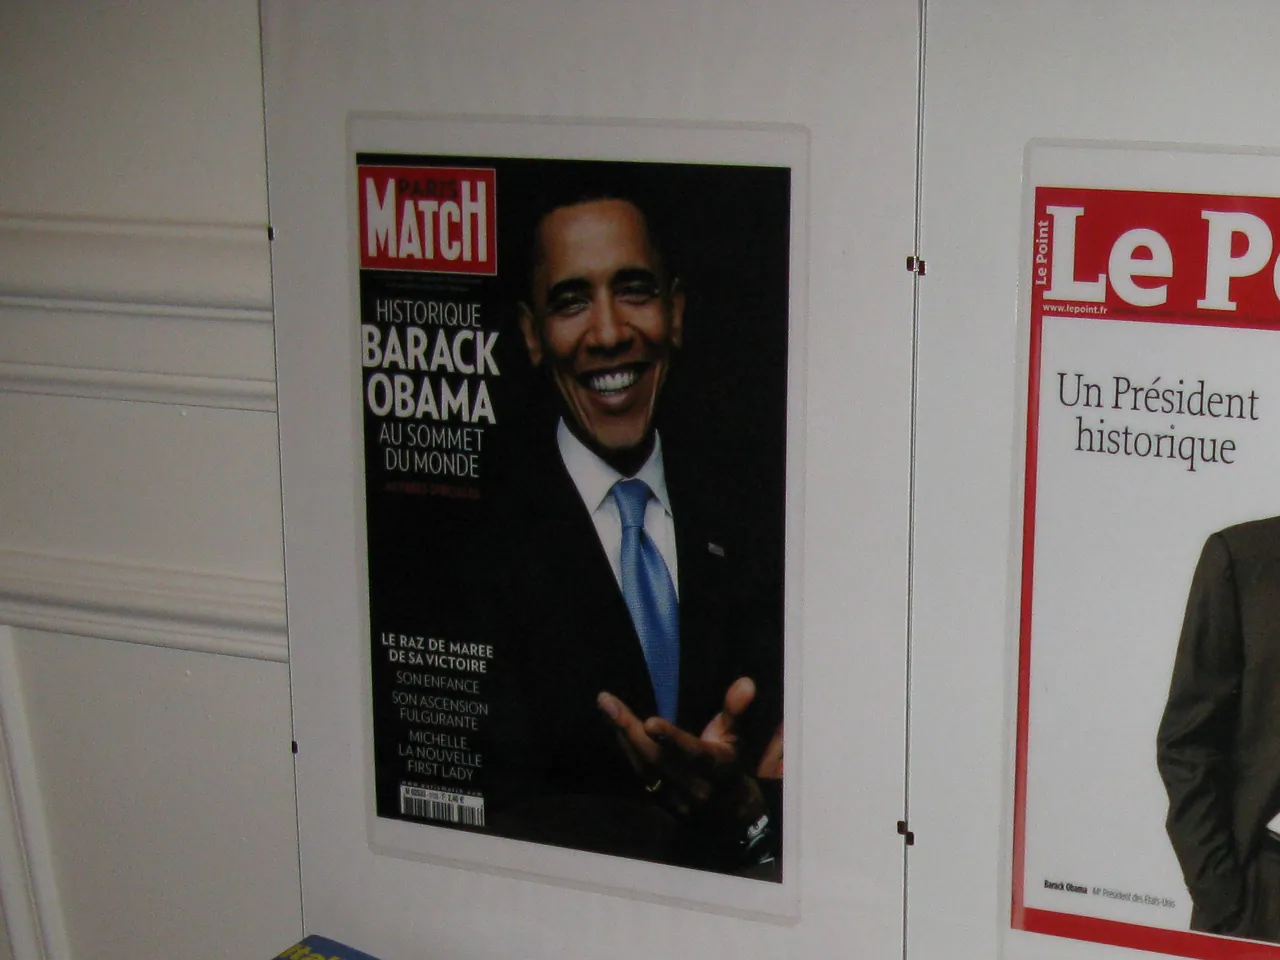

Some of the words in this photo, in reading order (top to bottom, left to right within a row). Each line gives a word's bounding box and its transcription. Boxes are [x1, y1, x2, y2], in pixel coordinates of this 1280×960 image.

[398, 178, 458, 198] PARIS
[366, 178, 488, 262] MATCH
[1036, 220, 1049, 264] Point
[1043, 205, 1174, 307] Le
[1036, 267, 1047, 286] Le
[376, 298, 482, 328] HISTORIQUE
[1042, 303, 1108, 315] www.lepoint.fr
[361, 324, 500, 376] BARACK
[367, 372, 497, 424] OBAMA
[1057, 372, 1102, 408] Un
[1111, 374, 1260, 422] Président
[379, 422, 402, 445] AU
[407, 424, 484, 452] SOMMET
[1075, 416, 1237, 472] historique
[385, 448, 410, 472] DU
[414, 451, 480, 478] MONDE
[382, 632, 396, 646] LE
[400, 635, 425, 650] RAZ
[428, 638, 445, 653] DE
[389, 649, 406, 663] DE
[408, 652, 424, 666] SA
[426, 654, 488, 673] VICTOIRE
[396, 671, 422, 686] SON
[424, 675, 480, 694] ENFANCE
[392, 691, 418, 705] SON
[419, 695, 489, 716] ASCENSION
[400, 708, 479, 731] FULGURANTE
[398, 744, 413, 757] LA
[416, 747, 483, 768] NOUVELLE
[407, 759, 439, 775] FIRST
[441, 764, 475, 782] LADY
[1044, 879, 1065, 892] Barack
[1065, 884, 1088, 894] Obama
